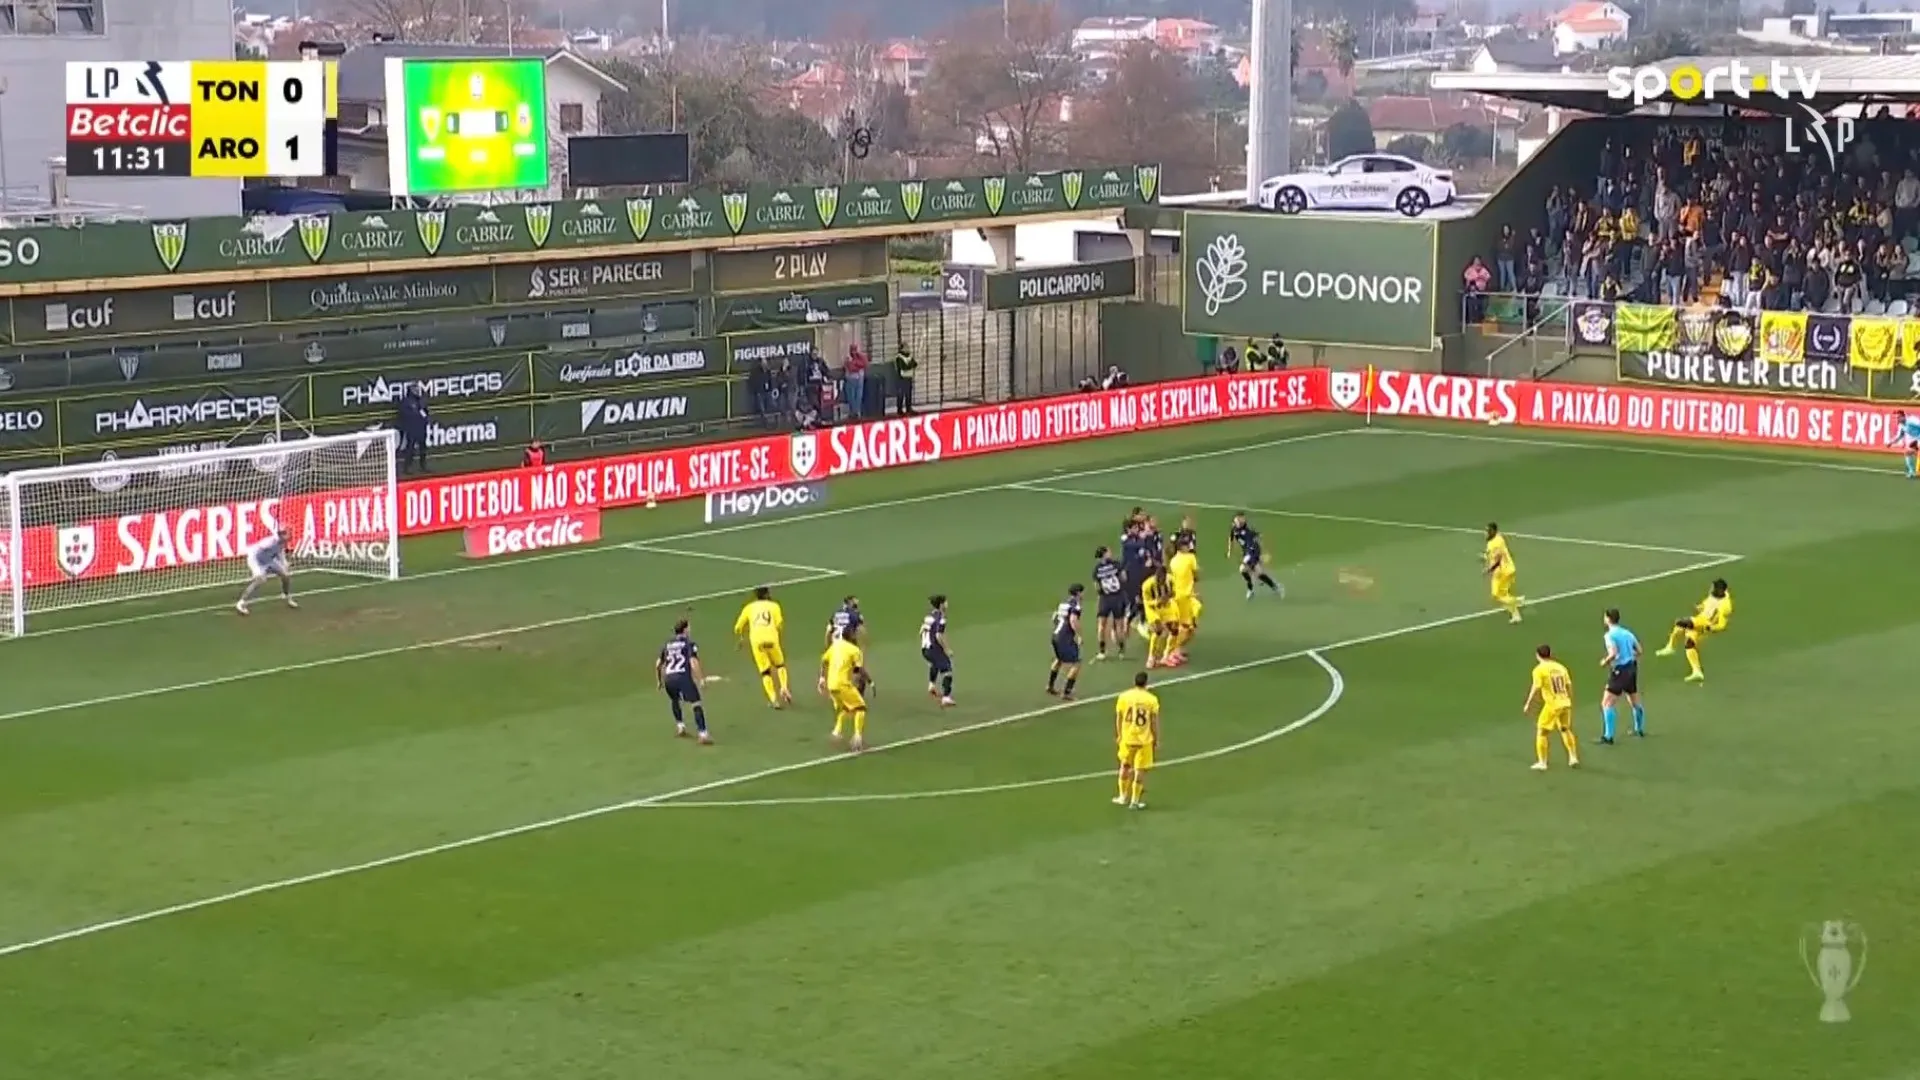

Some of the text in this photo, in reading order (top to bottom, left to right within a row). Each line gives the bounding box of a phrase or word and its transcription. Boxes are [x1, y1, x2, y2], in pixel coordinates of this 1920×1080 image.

[931, 192, 976, 210] CABRIZ
[1011, 188, 1054, 205] CABRIZ
[1089, 182, 1129, 199] CABRIZ
[756, 204, 805, 222] CABRIZ
[846, 199, 892, 217] CABRIZ
[562, 217, 616, 236] CABRIZ
[661, 211, 713, 231] CABRIZ
[341, 232, 404, 252] CABRIZ
[456, 224, 514, 243] CABRIZ
[218, 237, 286, 258] CABRIZ
[550, 268, 580, 288] SER
[592, 262, 662, 285] PARECER
[775, 252, 827, 279] 2 PLAY
[311, 283, 360, 311] Quinta
[373, 286, 399, 301] Vale
[403, 280, 457, 299] Minhoto
[1262, 270, 1422, 304] FLOPONOR
[71, 298, 113, 329] cuf
[197, 291, 236, 318] cuf
[654, 354, 670, 370] DA
[672, 350, 705, 368] BEIRA
[734, 342, 810, 360] FIGUEIRA FISH
[1377, 370, 1519, 425] SAGRES
[0, 410, 43, 431] ELO
[603, 396, 687, 424] DAIKIN
[953, 375, 1311, 451] A PAIXÃO DO FUTEBOL NÃO SE EXPLICA, SENTE-SE.
[1532, 397, 1544, 420] A
[1552, 387, 1620, 426] PAIXÃO
[1628, 403, 1653, 429] DO
[1661, 404, 1749, 435] FUTEBOL
[1758, 402, 1799, 440] NÃO
[1808, 409, 1833, 441] SE
[829, 413, 941, 475] SAGRES
[303, 502, 316, 538] A
[406, 489, 431, 527] DO
[440, 477, 522, 523] FUTEBOL
[531, 465, 568, 511] NÃO
[575, 468, 597, 506] SE
[604, 459, 681, 501] EXPLICA,
[689, 445, 775, 489] SENTE-SE.
[116, 499, 283, 574] SAGRES
[488, 512, 584, 556] Betclic
[666, 656, 686, 675] 22
[1125, 706, 1147, 726] 48
